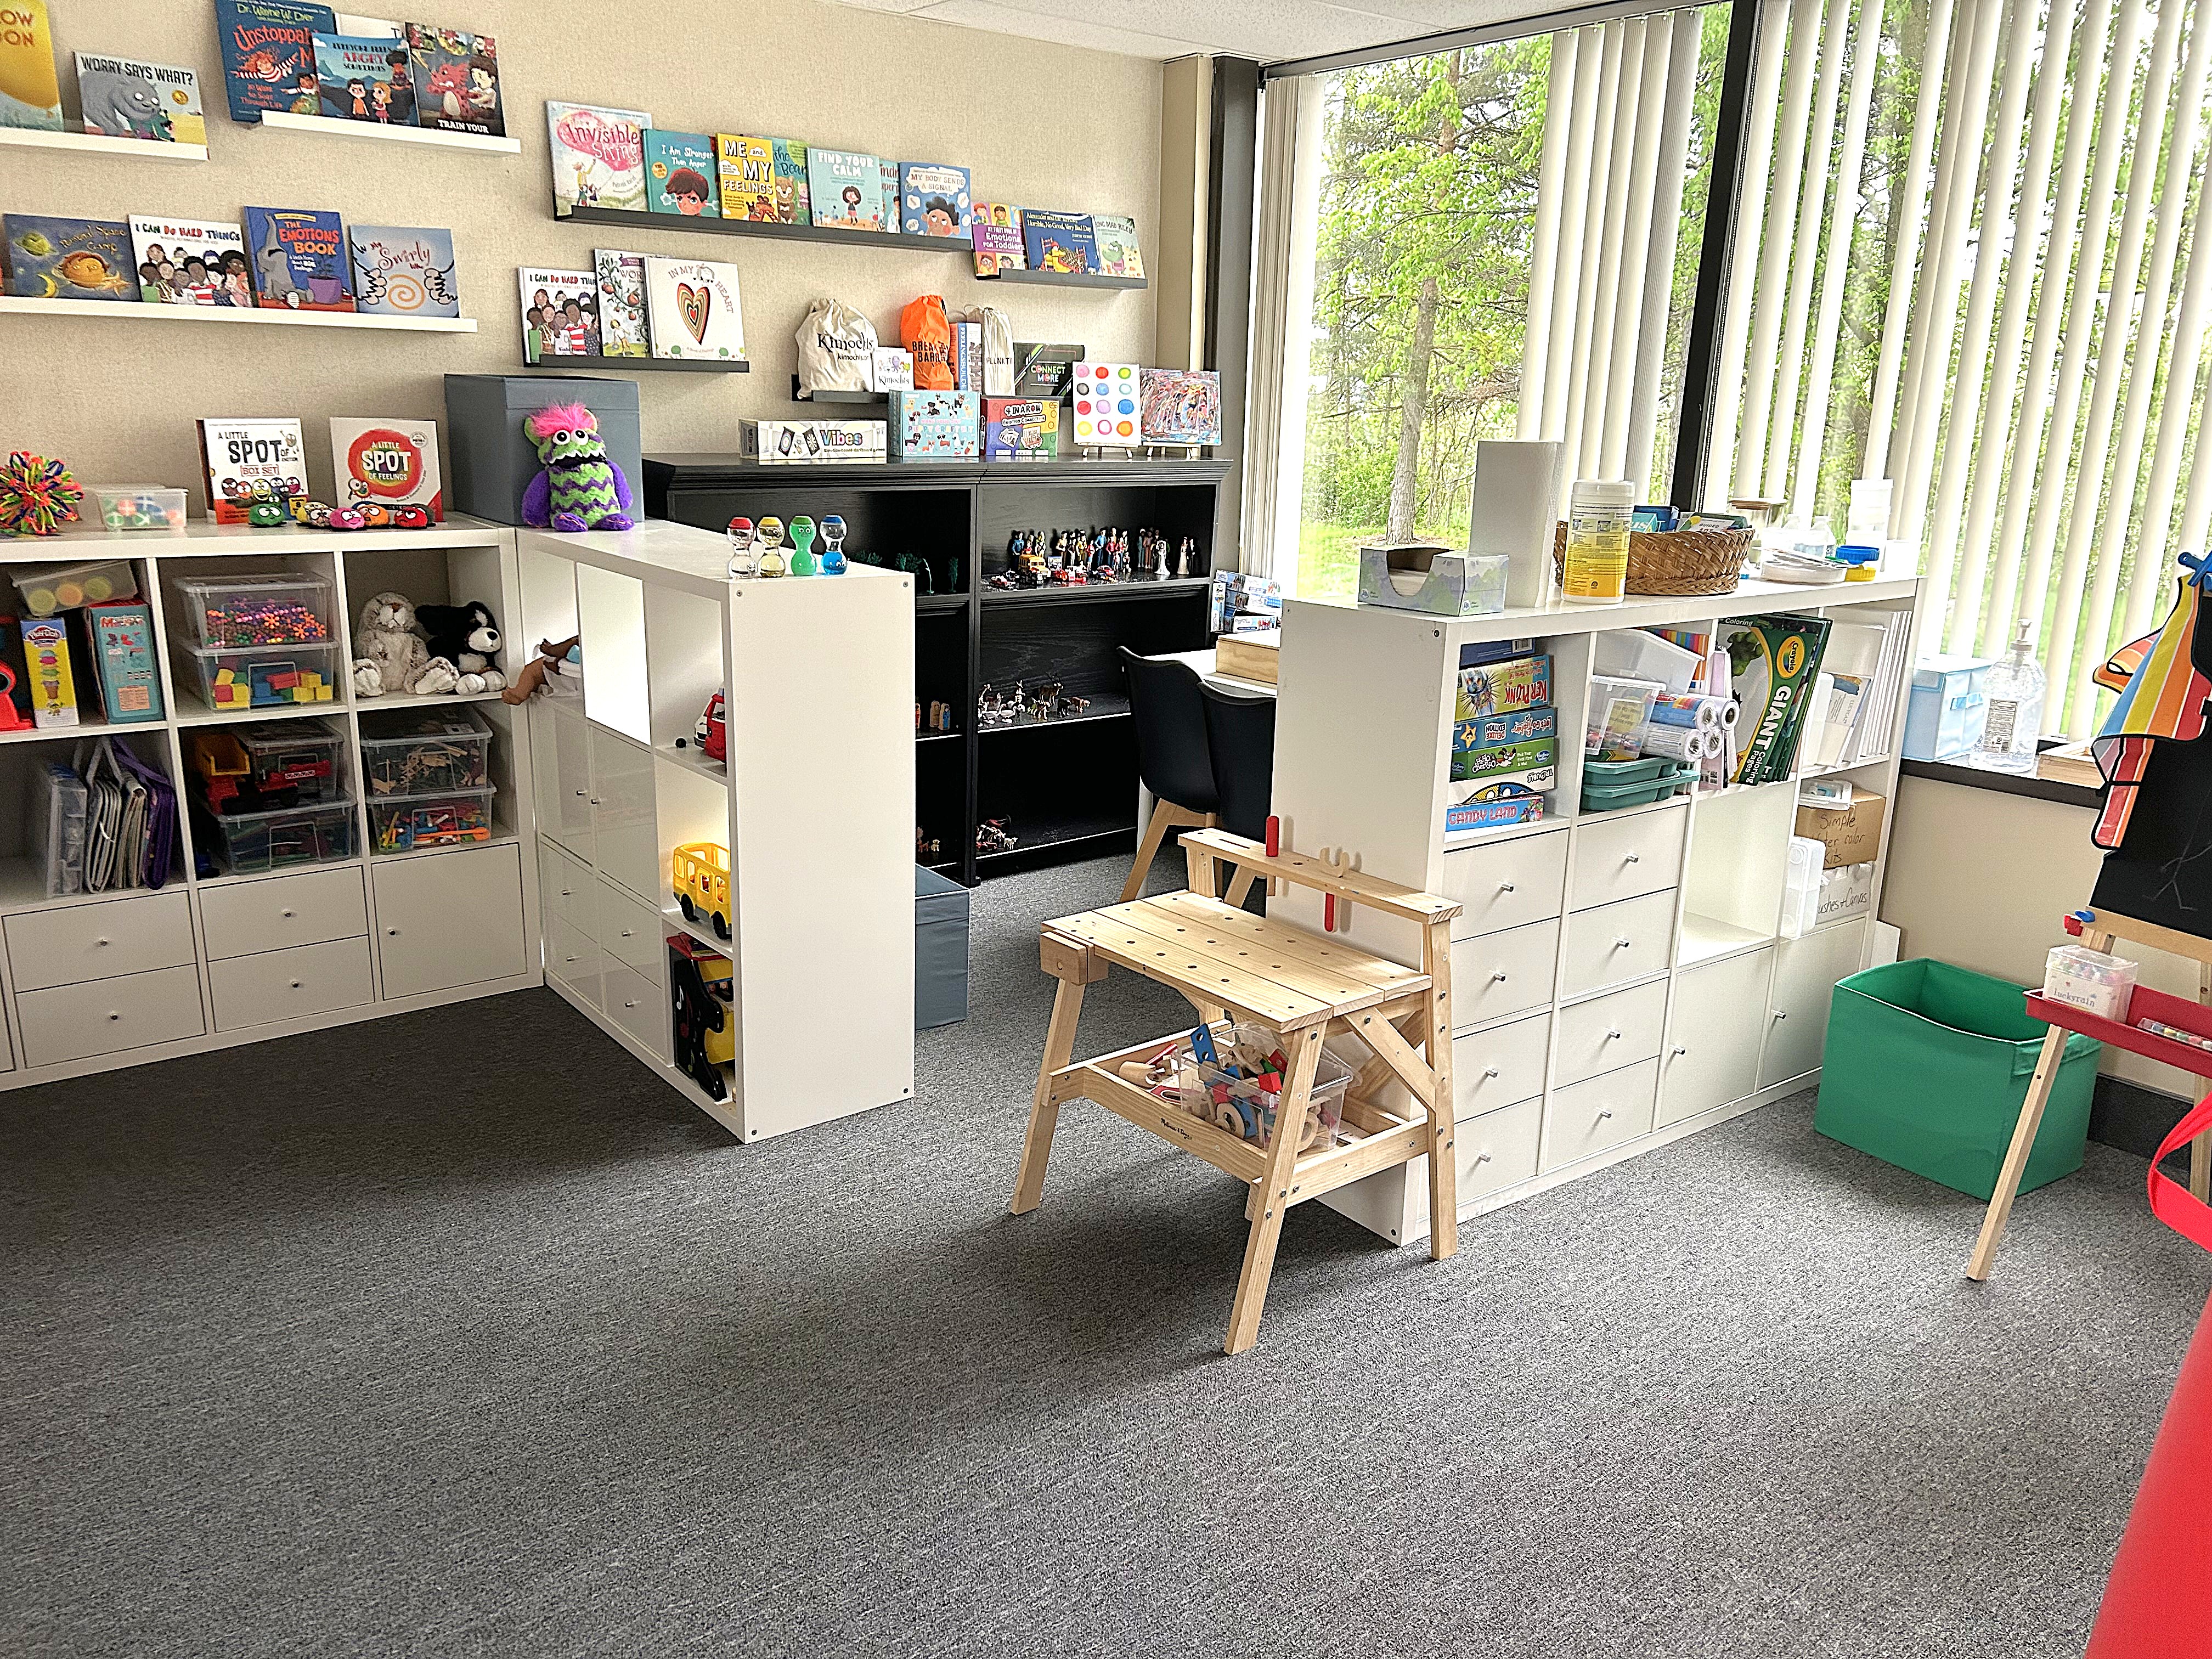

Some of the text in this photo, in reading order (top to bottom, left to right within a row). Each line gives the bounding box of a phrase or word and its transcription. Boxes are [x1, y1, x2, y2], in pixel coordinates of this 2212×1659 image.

[80, 57, 194, 86] WORRY SAYS WHAT?
[438, 119, 489, 133] TRAIN YOUR
[566, 124, 639, 145] Invisible
[592, 143, 639, 165] String
[661, 144, 714, 160] I Am Stronger
[724, 139, 748, 159] ME
[817, 152, 874, 168] FIND YOUR
[742, 159, 771, 183] MY
[832, 164, 862, 177] CALM
[724, 179, 774, 195] FEELINGS
[928, 183, 952, 191] SIGNAL
[944, 177, 965, 185] SENDS
[135, 223, 140, 232] I
[143, 223, 161, 234] CAN
[205, 230, 241, 241] THINGS
[1105, 221, 1117, 229] MAD
[279, 228, 340, 244] EMOTIONS
[985, 232, 1021, 243] Emotions
[293, 241, 337, 256] BOOK
[994, 240, 1025, 251] Toddlers
[535, 274, 548, 283] CAN
[561, 275, 579, 284] HARD
[668, 266, 734, 314] IN MY HEART
[1030, 365, 1066, 374] CONNECT
[1037, 374, 1059, 382] MORE
[1012, 407, 1019, 415] IN
[1020, 406, 1025, 414] A
[1026, 404, 1041, 413] ROW
[819, 430, 864, 446] Vibes
[228, 439, 282, 464] SPOT
[280, 448, 290, 457] OF
[361, 450, 411, 472] SPOT
[243, 466, 279, 475] BOX SET
[378, 473, 408, 481] FEELINGS
[1725, 617, 1754, 627] Coloring
[1789, 642, 1798, 674] Crayola
[1756, 685, 1792, 751] GIANT
[1745, 750, 1759, 773] Pages
[1746, 752, 1766, 785] Coloring
[1528, 769, 1553, 783] TROUBLE
[1448, 805, 1517, 826] CANDY LAND
[1820, 814, 1856, 831] Simple
[1844, 829, 1866, 845] color
[1846, 887, 1867, 907] Canvas
[2053, 988, 2095, 1008] luckyrain
